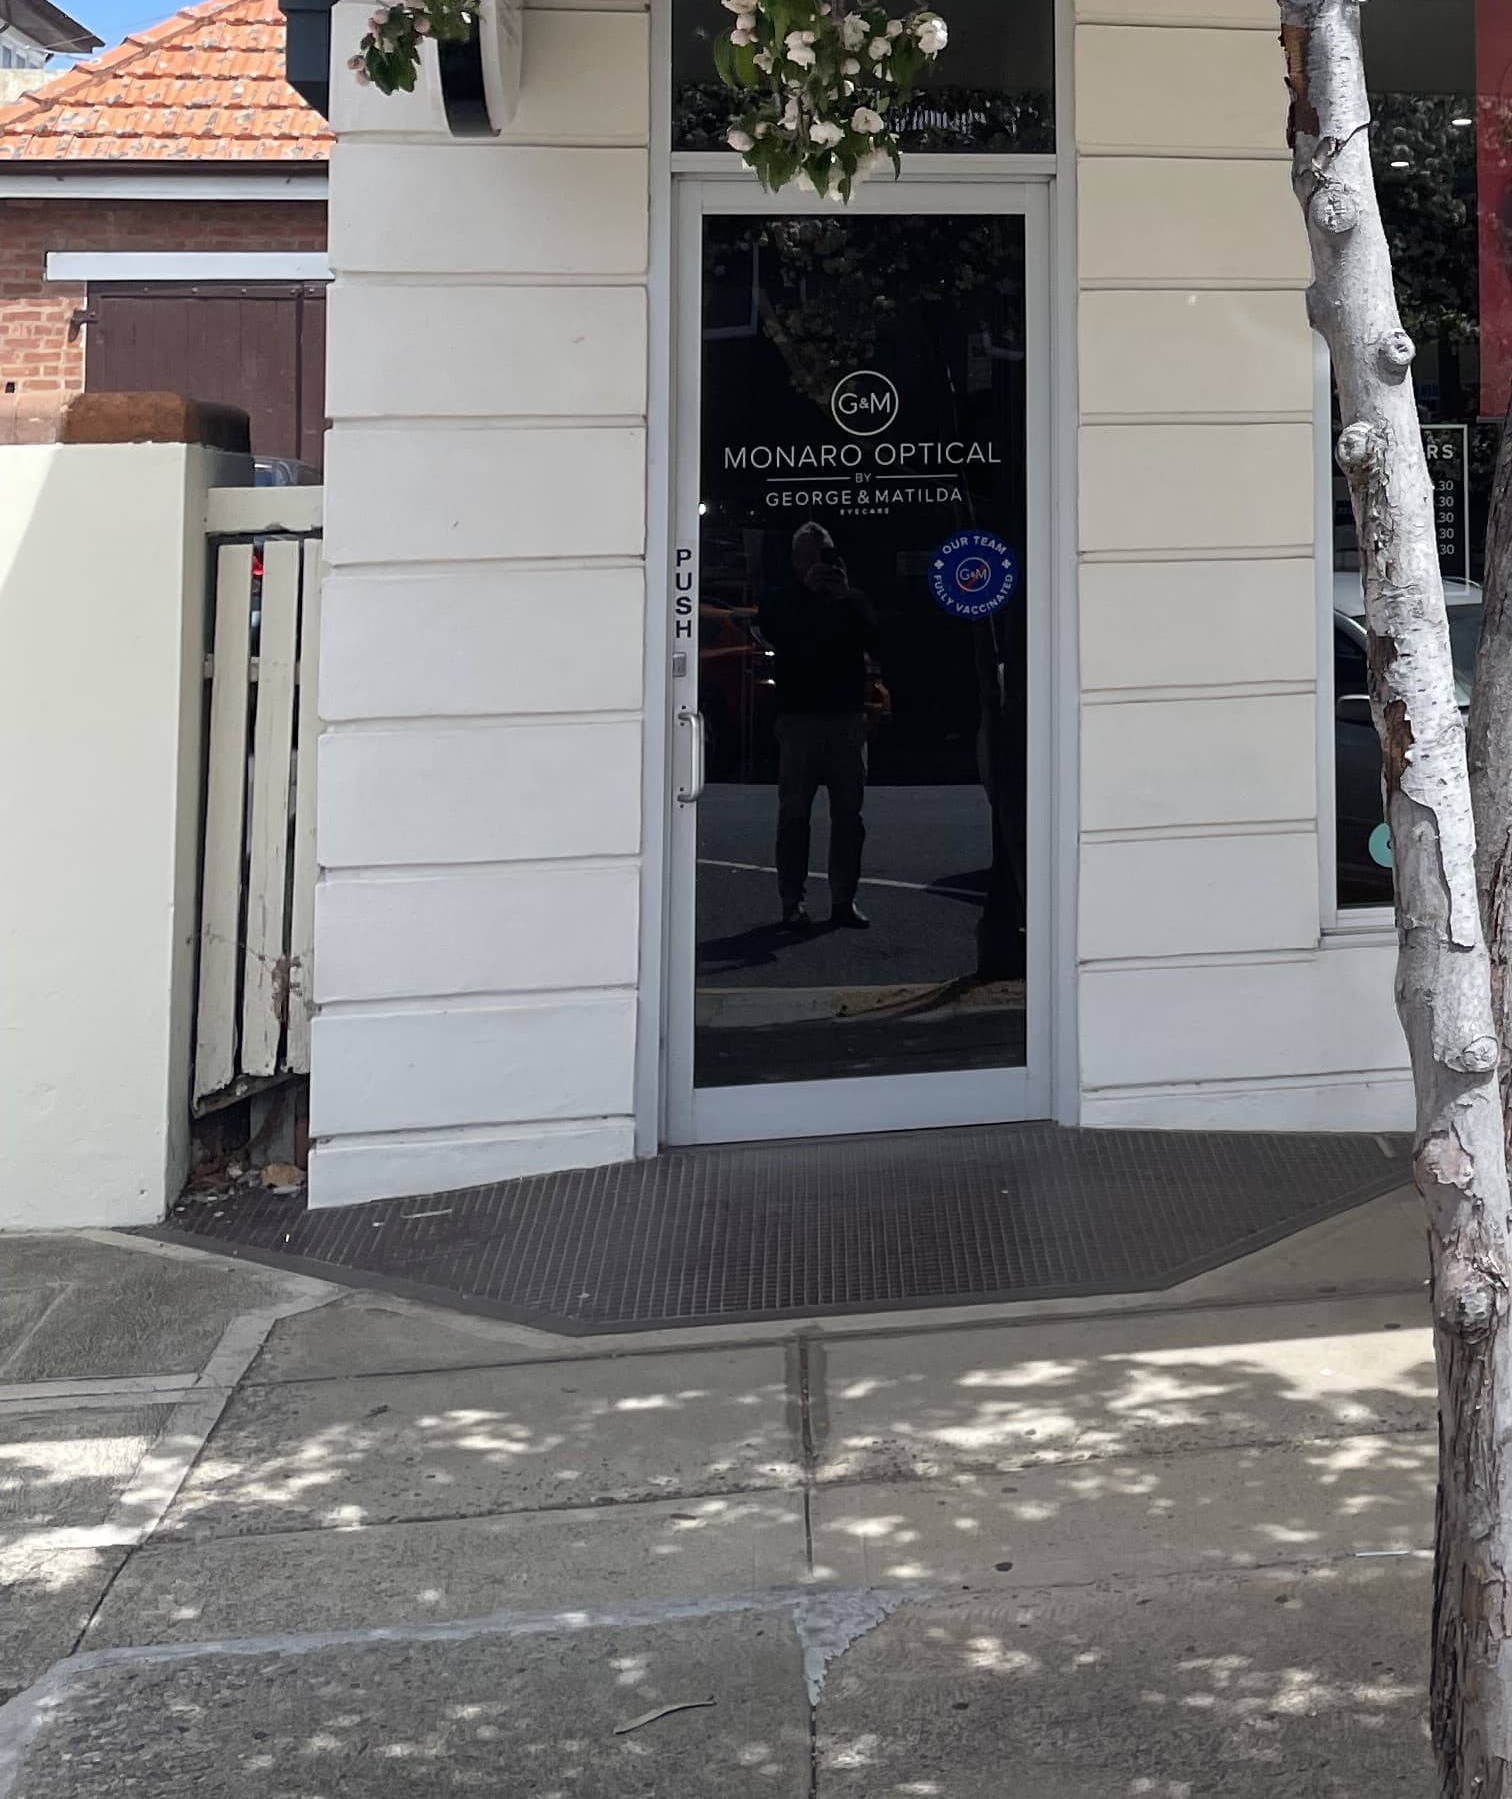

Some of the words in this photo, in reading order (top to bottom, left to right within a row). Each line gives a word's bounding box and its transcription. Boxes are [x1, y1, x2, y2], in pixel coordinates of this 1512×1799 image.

[838, 392, 890, 415] G&M
[724, 445, 862, 469] MONARO
[874, 442, 1002, 465] OPTICAL
[855, 472, 872, 483] BY
[766, 489, 851, 507] GEORGE
[857, 489, 870, 505] &
[875, 487, 963, 503] MATILDA
[840, 507, 890, 516] EYECARE
[942, 536, 969, 555] OUR
[973, 535, 1007, 555] TEAM
[675, 548, 692, 638] PUSH
[933, 574, 955, 606] FULLY
[956, 573, 1014, 615] VACCINATED
